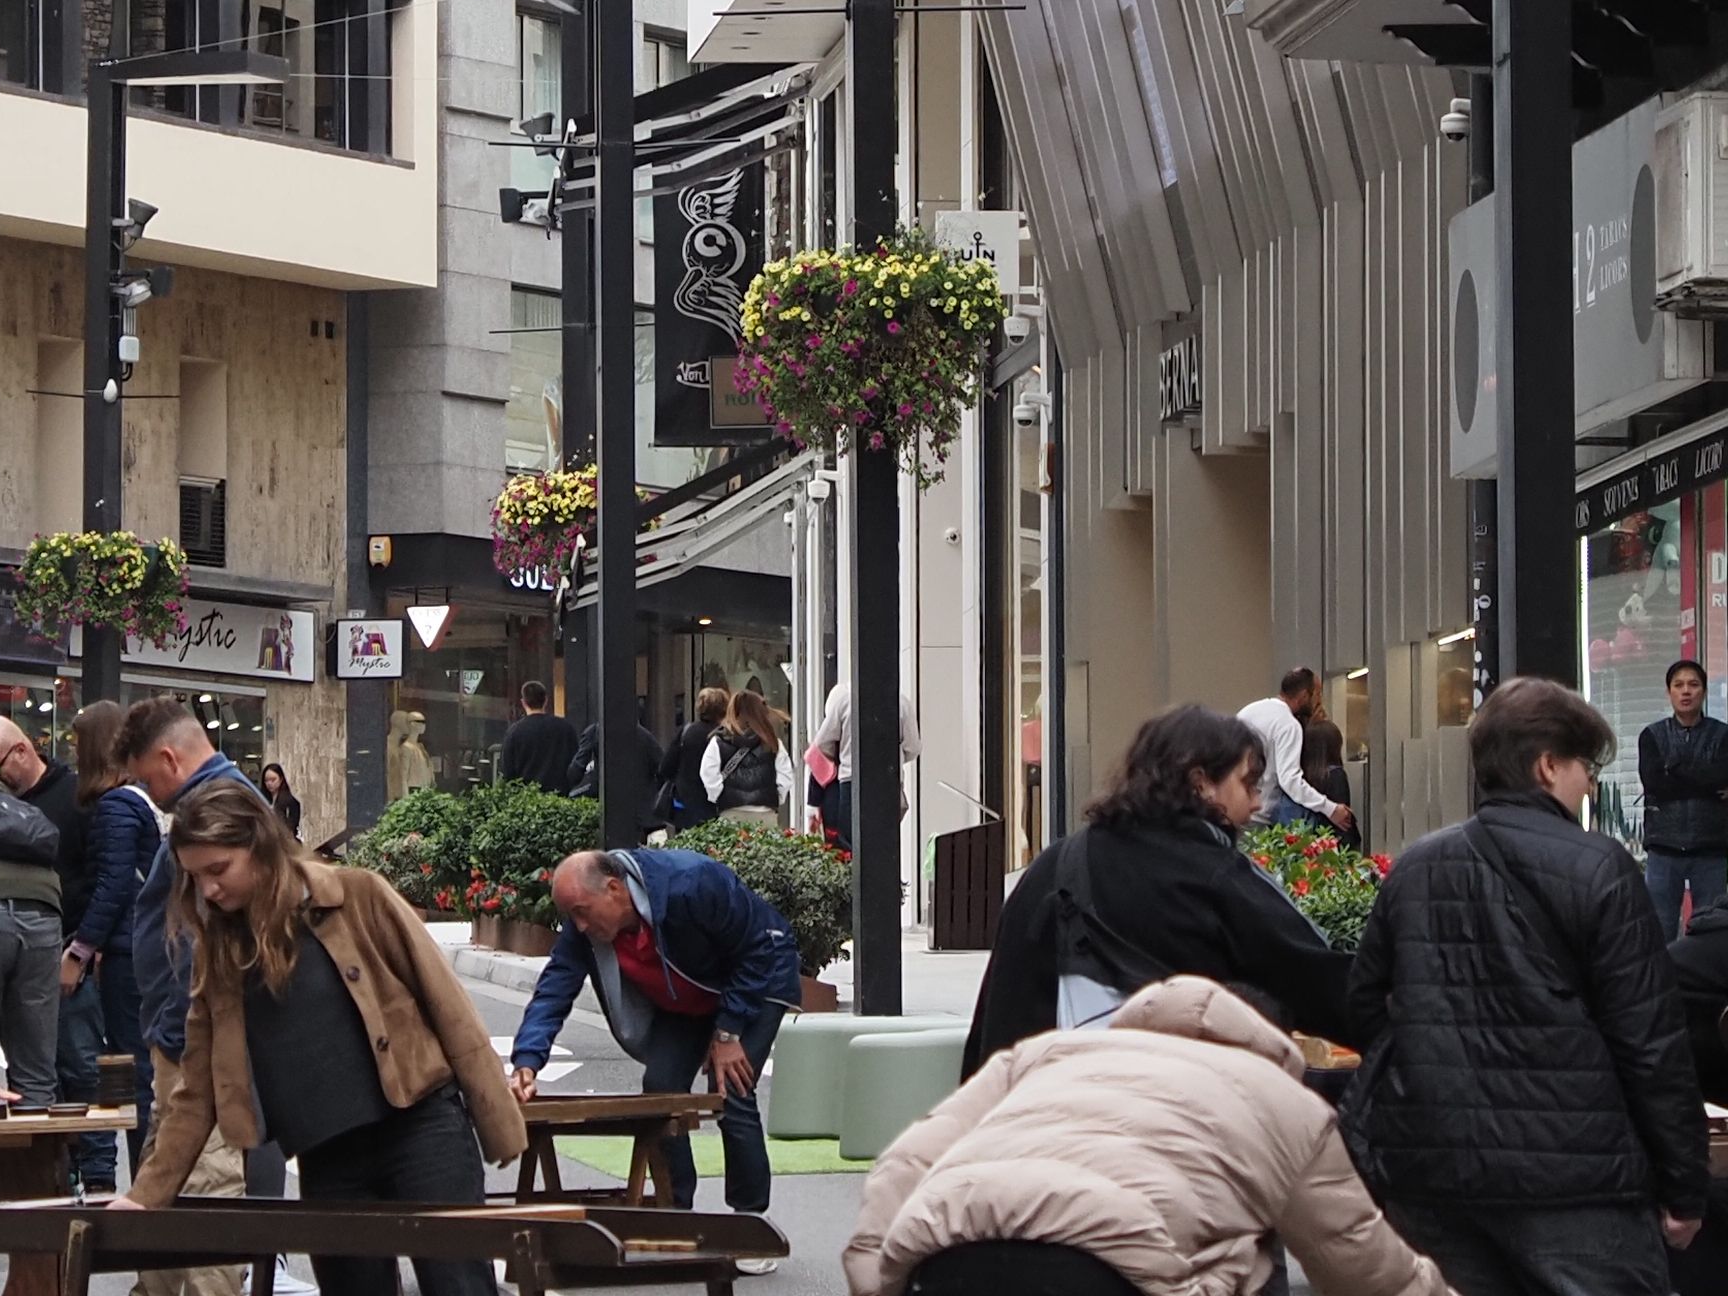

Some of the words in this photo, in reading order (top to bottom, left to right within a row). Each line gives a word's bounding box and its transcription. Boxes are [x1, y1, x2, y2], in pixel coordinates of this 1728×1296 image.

[1599, 216, 1628, 251] TABACS
[1600, 256, 1629, 291] LICORS
[152, 607, 237, 663] ystic
